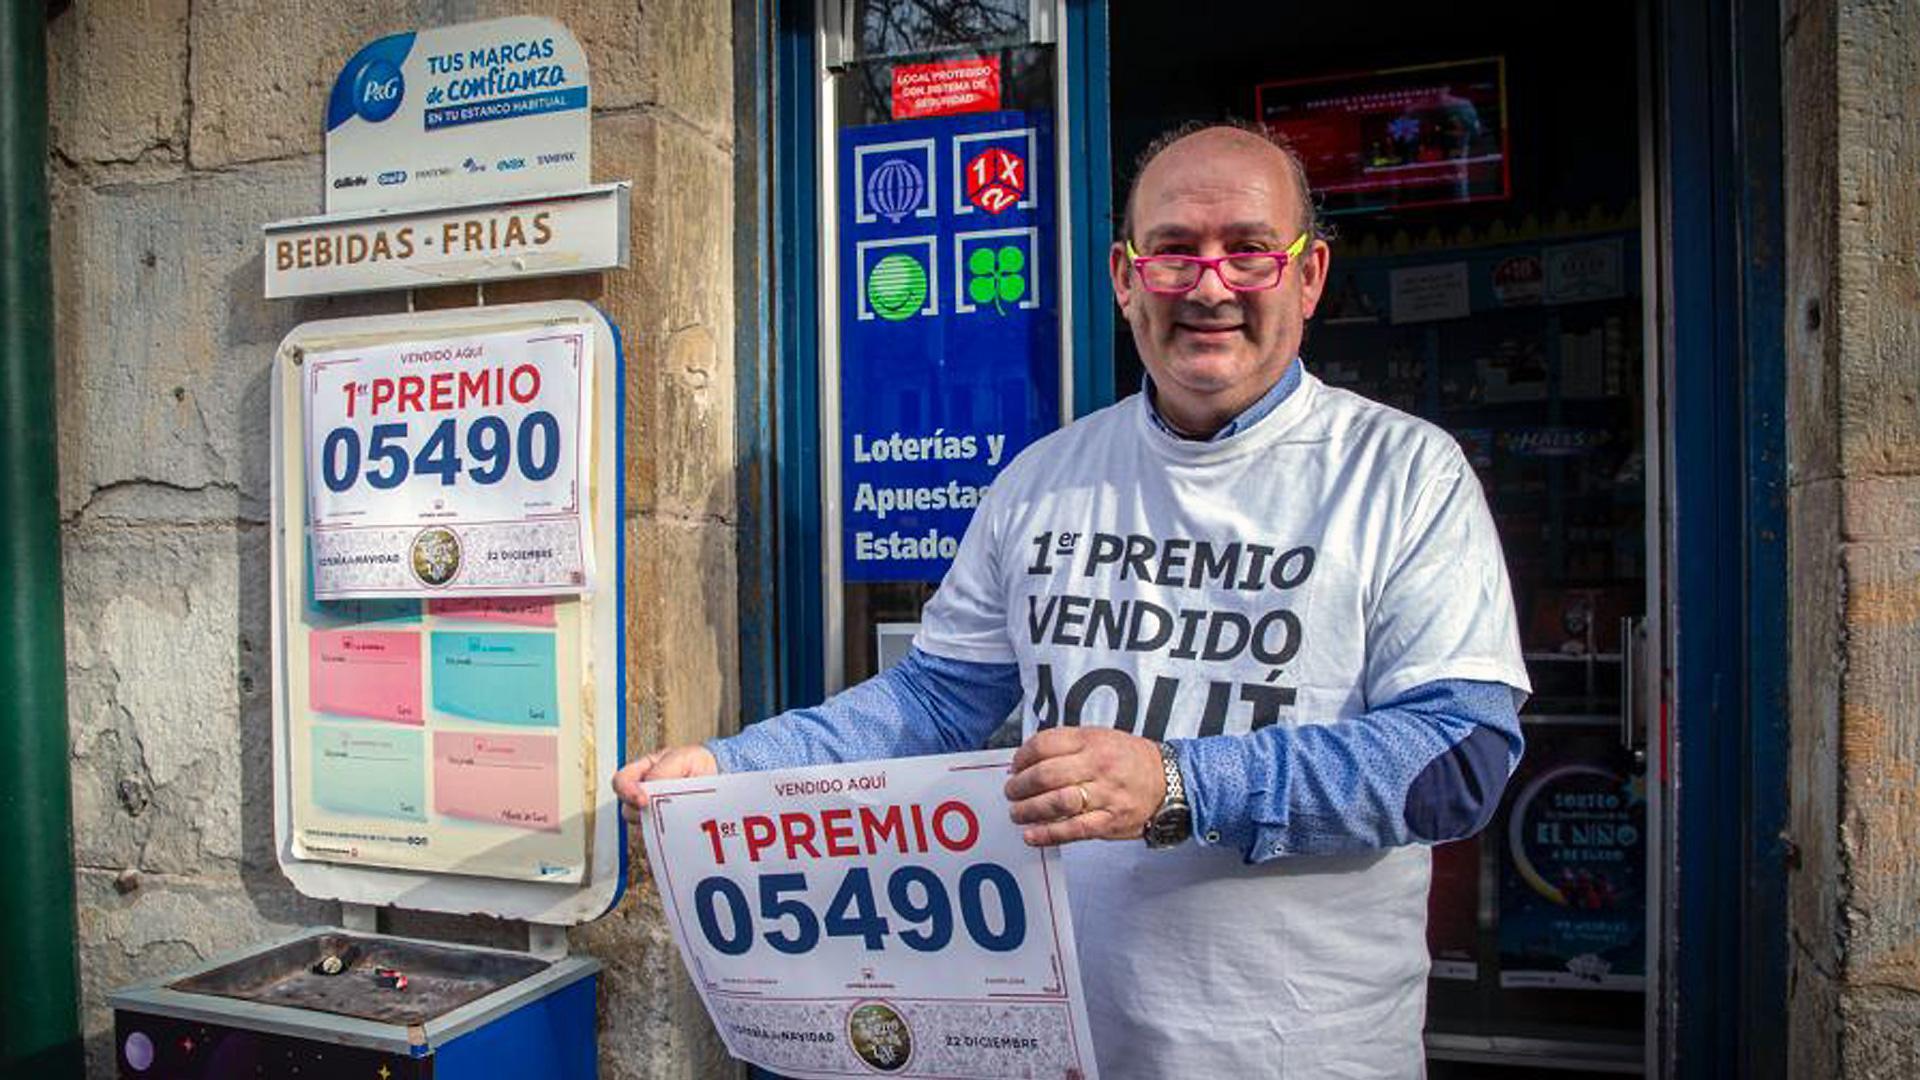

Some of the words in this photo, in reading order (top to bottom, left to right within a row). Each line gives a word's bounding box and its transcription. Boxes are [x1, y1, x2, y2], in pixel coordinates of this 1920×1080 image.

[428, 53, 464, 75] TUS
[470, 38, 554, 69] MARCAS
[364, 77, 398, 104] P&G
[426, 86, 444, 105] de
[447, 66, 566, 102] confianza
[897, 72, 931, 86] LOCAL
[428, 112, 443, 124] EN
[445, 110, 460, 122] TU
[461, 104, 512, 121] ESTANCO
[513, 96, 568, 114] HABITUAL
[972, 157, 987, 186] 1
[1000, 154, 1019, 187] X
[981, 187, 1015, 210] 2
[276, 228, 414, 272] BEBIDAS
[443, 211, 553, 255] FRIAS
[400, 349, 451, 365] VENDIDO
[370, 363, 542, 417] PREMIO
[322, 411, 561, 494] 05490
[853, 428, 978, 463] Loterías
[985, 434, 1006, 466] y
[855, 528, 958, 561] Estado
[1084, 532, 1317, 591] PREMIO
[1028, 595, 1302, 666] VENDIDO
[775, 777, 843, 798] VENDIDO
[848, 771, 887, 791] AQUÍ
[743, 800, 980, 863] PREMIO
[1538, 822, 1563, 844] EL
[693, 862, 1028, 956] 05490
[780, 1030, 836, 1044] NAVIDAD
[944, 1034, 962, 1047] 22
[962, 1035, 1039, 1050] DICIEMBRE
